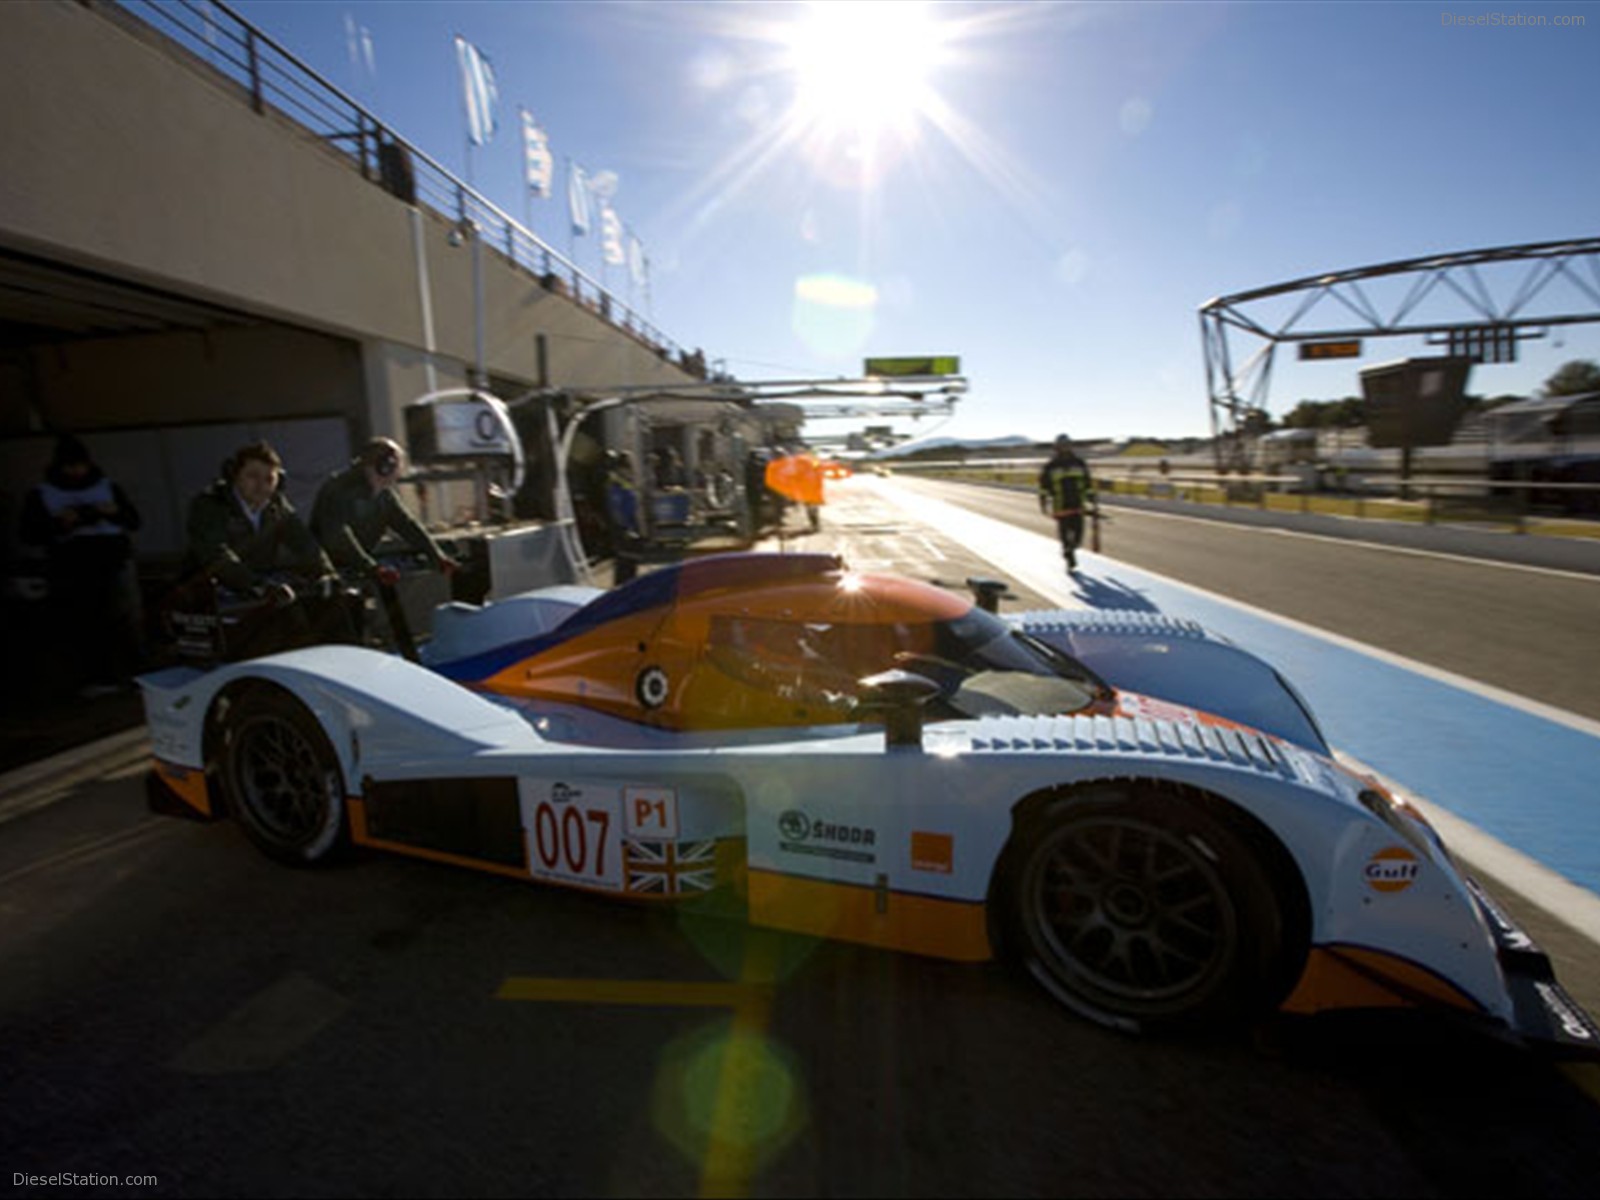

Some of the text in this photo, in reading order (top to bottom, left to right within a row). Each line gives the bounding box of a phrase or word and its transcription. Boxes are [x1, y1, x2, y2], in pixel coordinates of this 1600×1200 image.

[634, 798, 667, 828] P1
[535, 801, 609, 877] 007
[1365, 863, 1419, 879] Gulf
